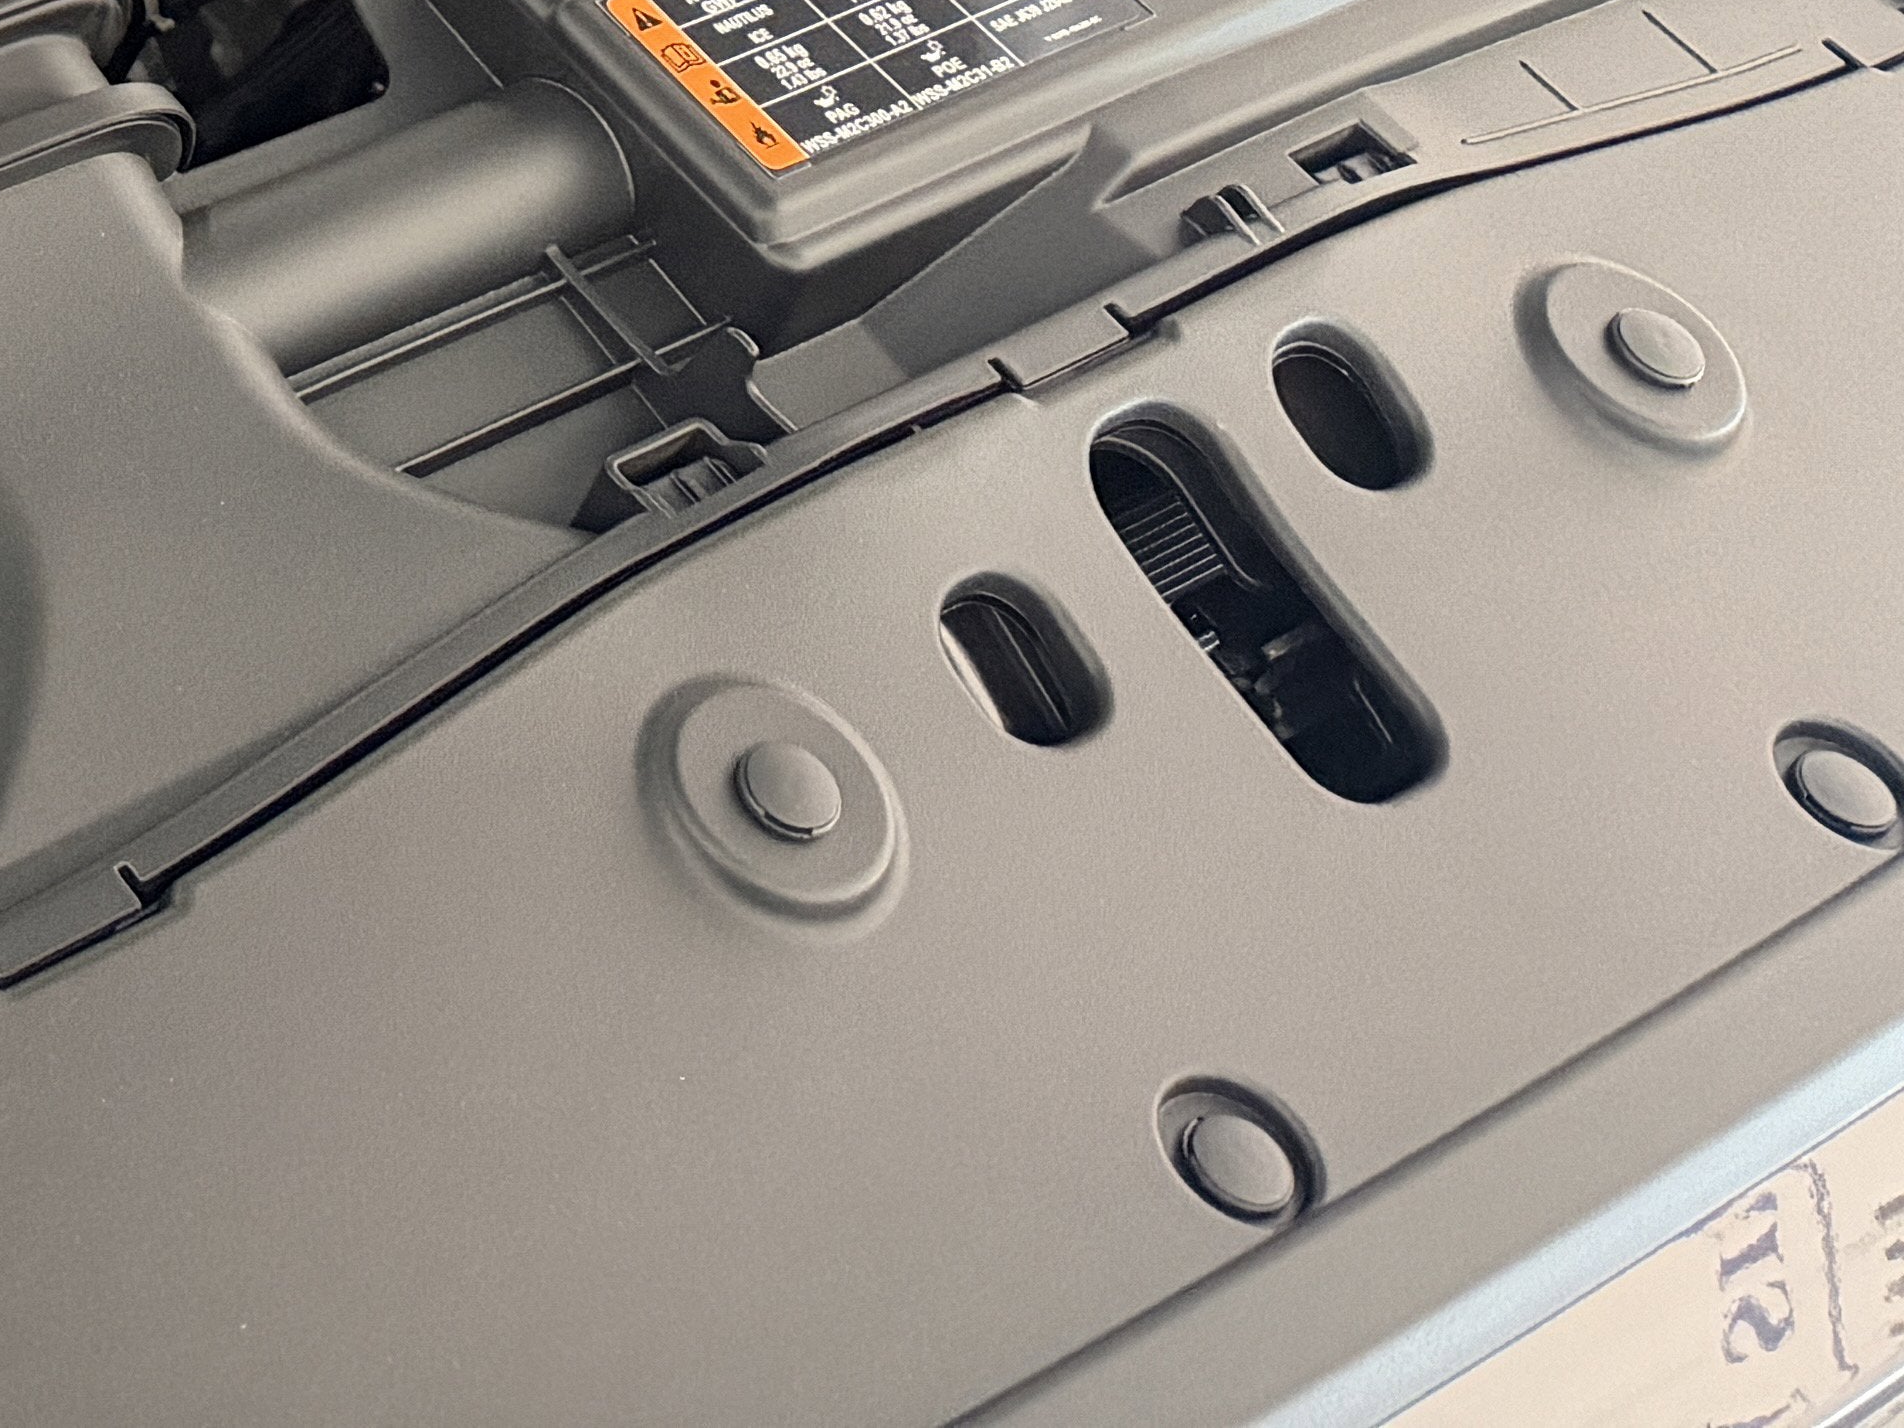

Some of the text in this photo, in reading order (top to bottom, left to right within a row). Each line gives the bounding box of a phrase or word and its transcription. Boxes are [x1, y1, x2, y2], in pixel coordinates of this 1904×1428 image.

[713, 4, 773, 34] NAUTILUS
[859, 1, 912, 25] 0.62 kg
[990, 14, 1018, 32] SAE
[748, 28, 773, 43] ICE
[875, 14, 918, 35] 21.9 oz
[885, 24, 930, 46] 1.37 lbs
[754, 44, 808, 68] 0.65 kg
[771, 56, 814, 78] 22.9 oz
[931, 57, 967, 77] POE
[781, 68, 827, 89] 1.43 lbs
[913, 56, 1016, 105] WSS-M2C31-B2
[825, 103, 860, 123] PAG
[800, 101, 913, 153] WSS-M2C300-A2
